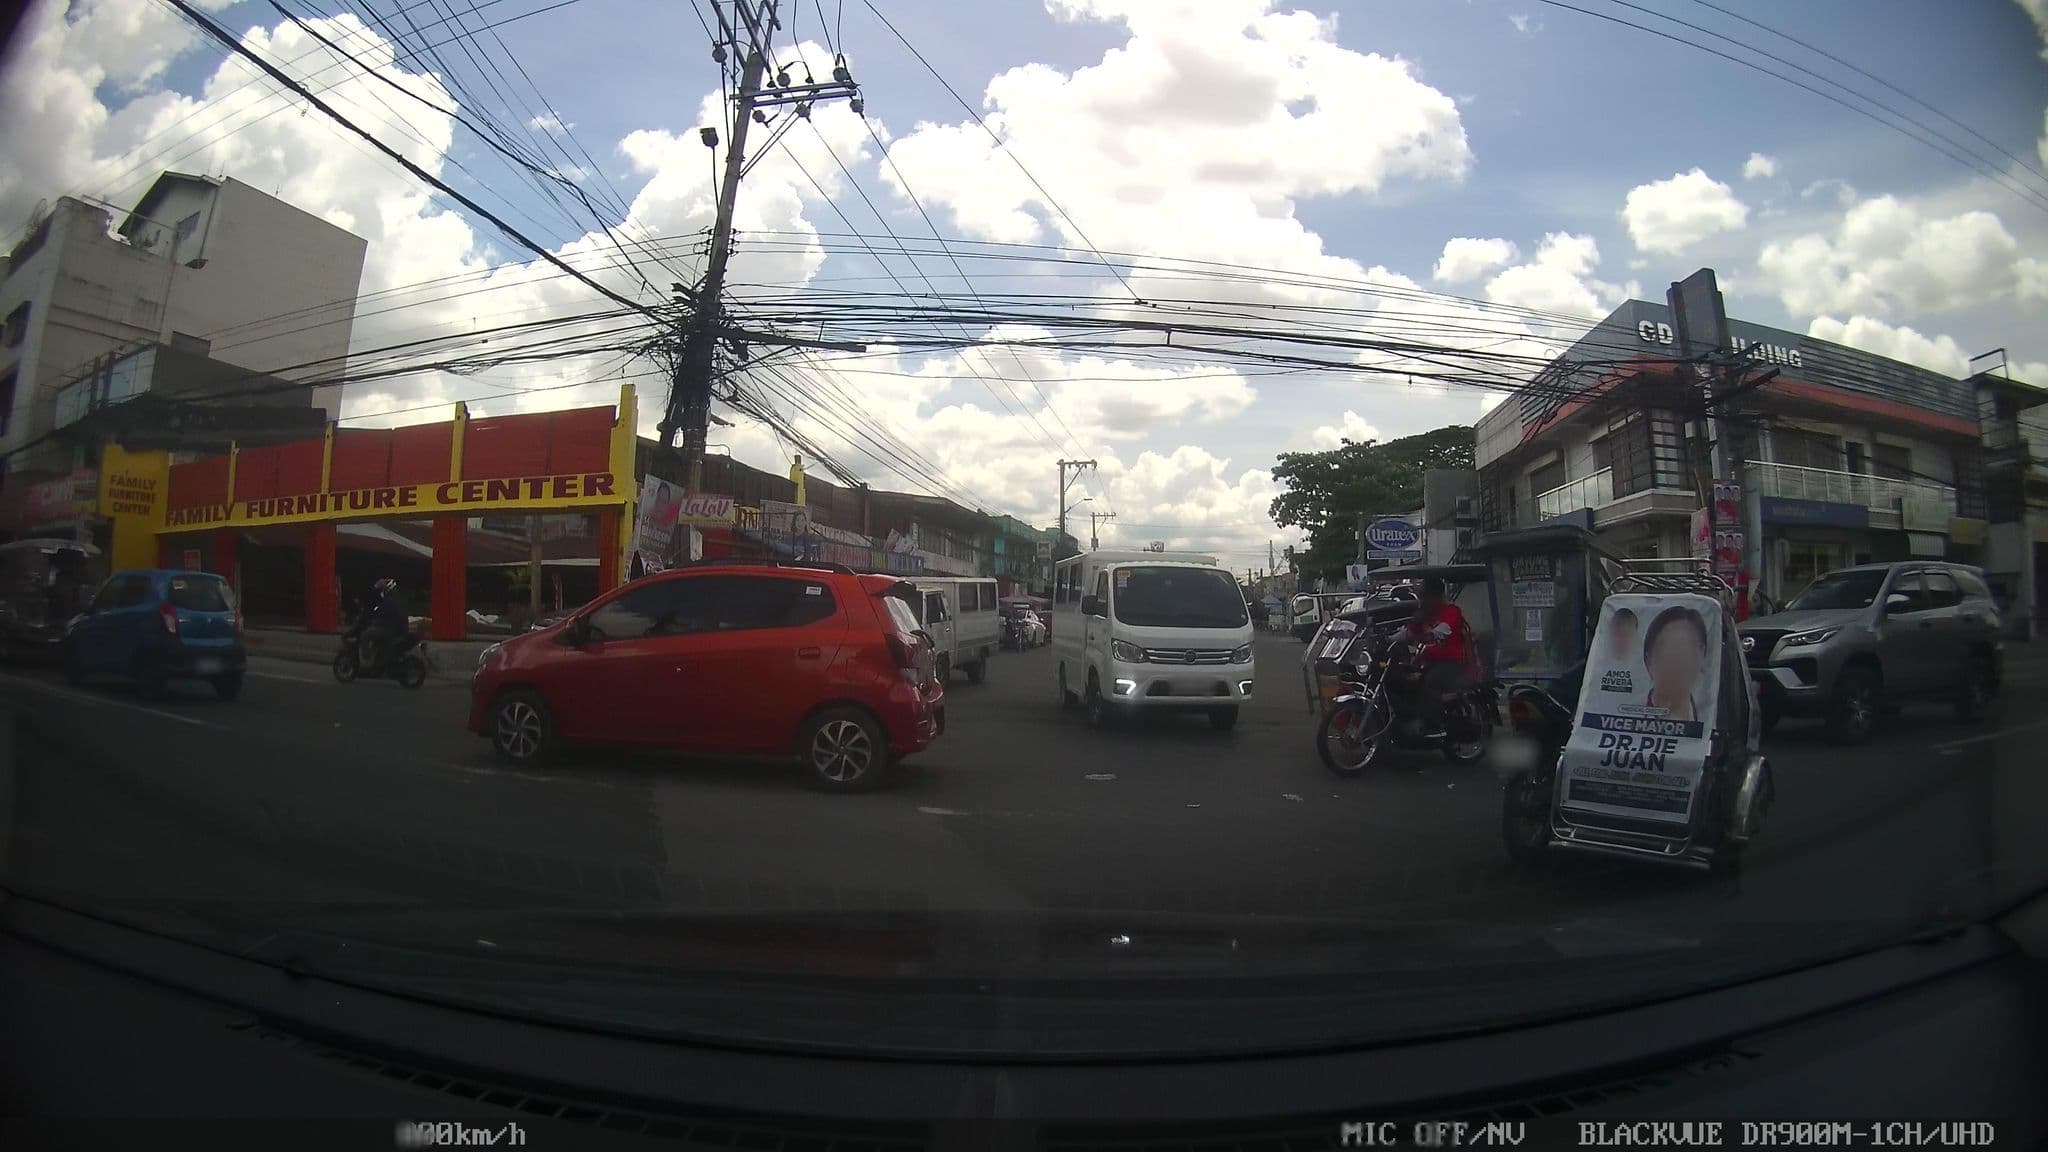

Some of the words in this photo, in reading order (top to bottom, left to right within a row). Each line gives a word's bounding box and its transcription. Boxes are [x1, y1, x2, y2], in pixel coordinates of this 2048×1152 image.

[1730, 336, 1803, 368] ILDING
[111, 475, 157, 489] FAMILY
[165, 503, 235, 528] FAMILY
[246, 485, 418, 517] FURNITURE
[437, 472, 616, 504] CENTER
[1600, 677, 1633, 686] RIVERA
[1605, 670, 1631, 679] AMOS
[1601, 716, 1632, 730] VICE
[1635, 719, 1686, 735] MAYOR
[1600, 750, 1665, 772] JUAN
